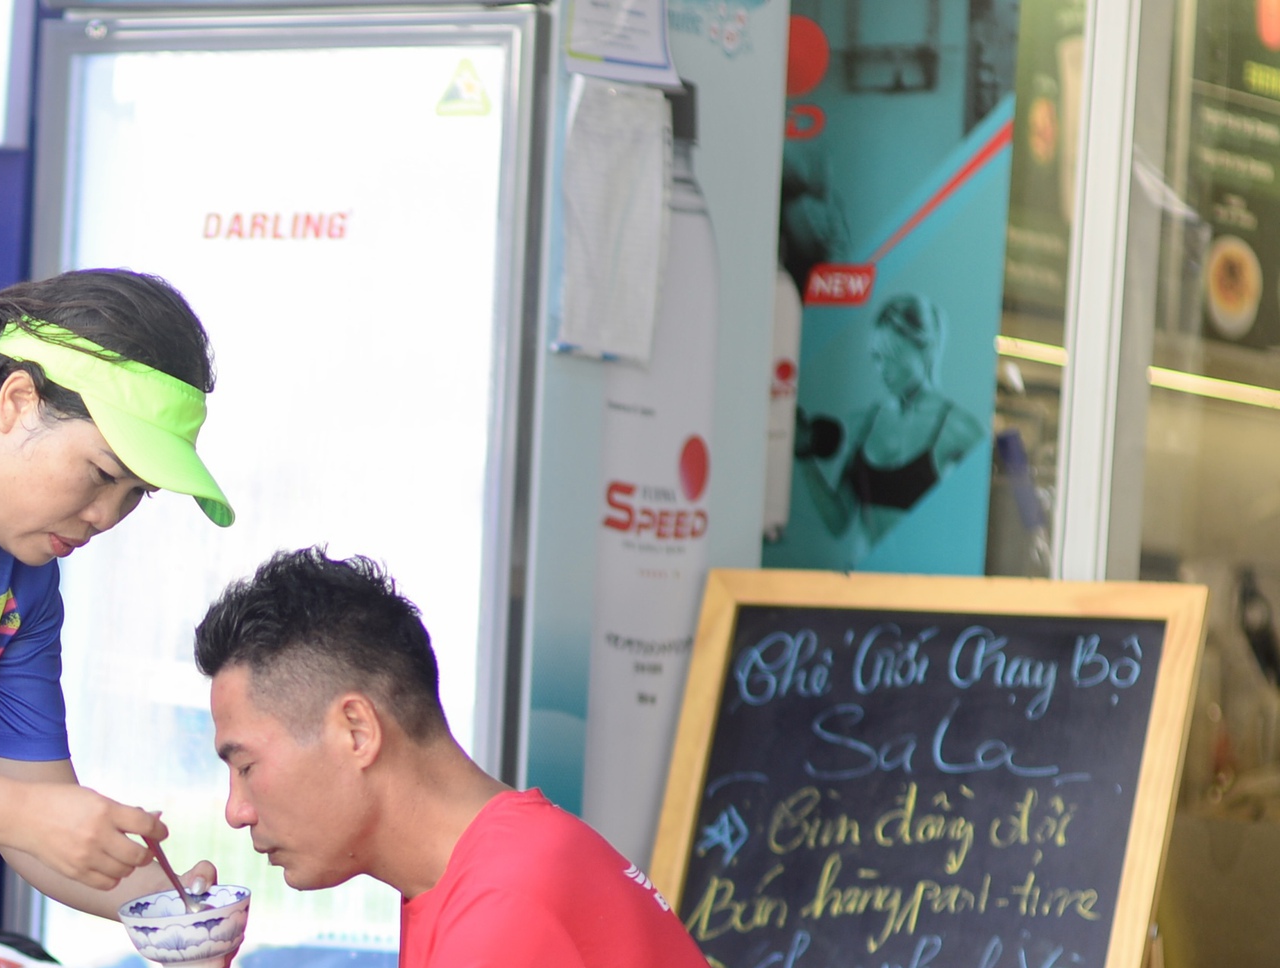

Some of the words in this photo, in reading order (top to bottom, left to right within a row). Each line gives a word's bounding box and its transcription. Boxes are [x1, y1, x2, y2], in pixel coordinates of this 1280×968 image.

[202, 211, 348, 241] DARLING
[810, 271, 870, 299] NEW
[602, 479, 709, 541] SPEED
